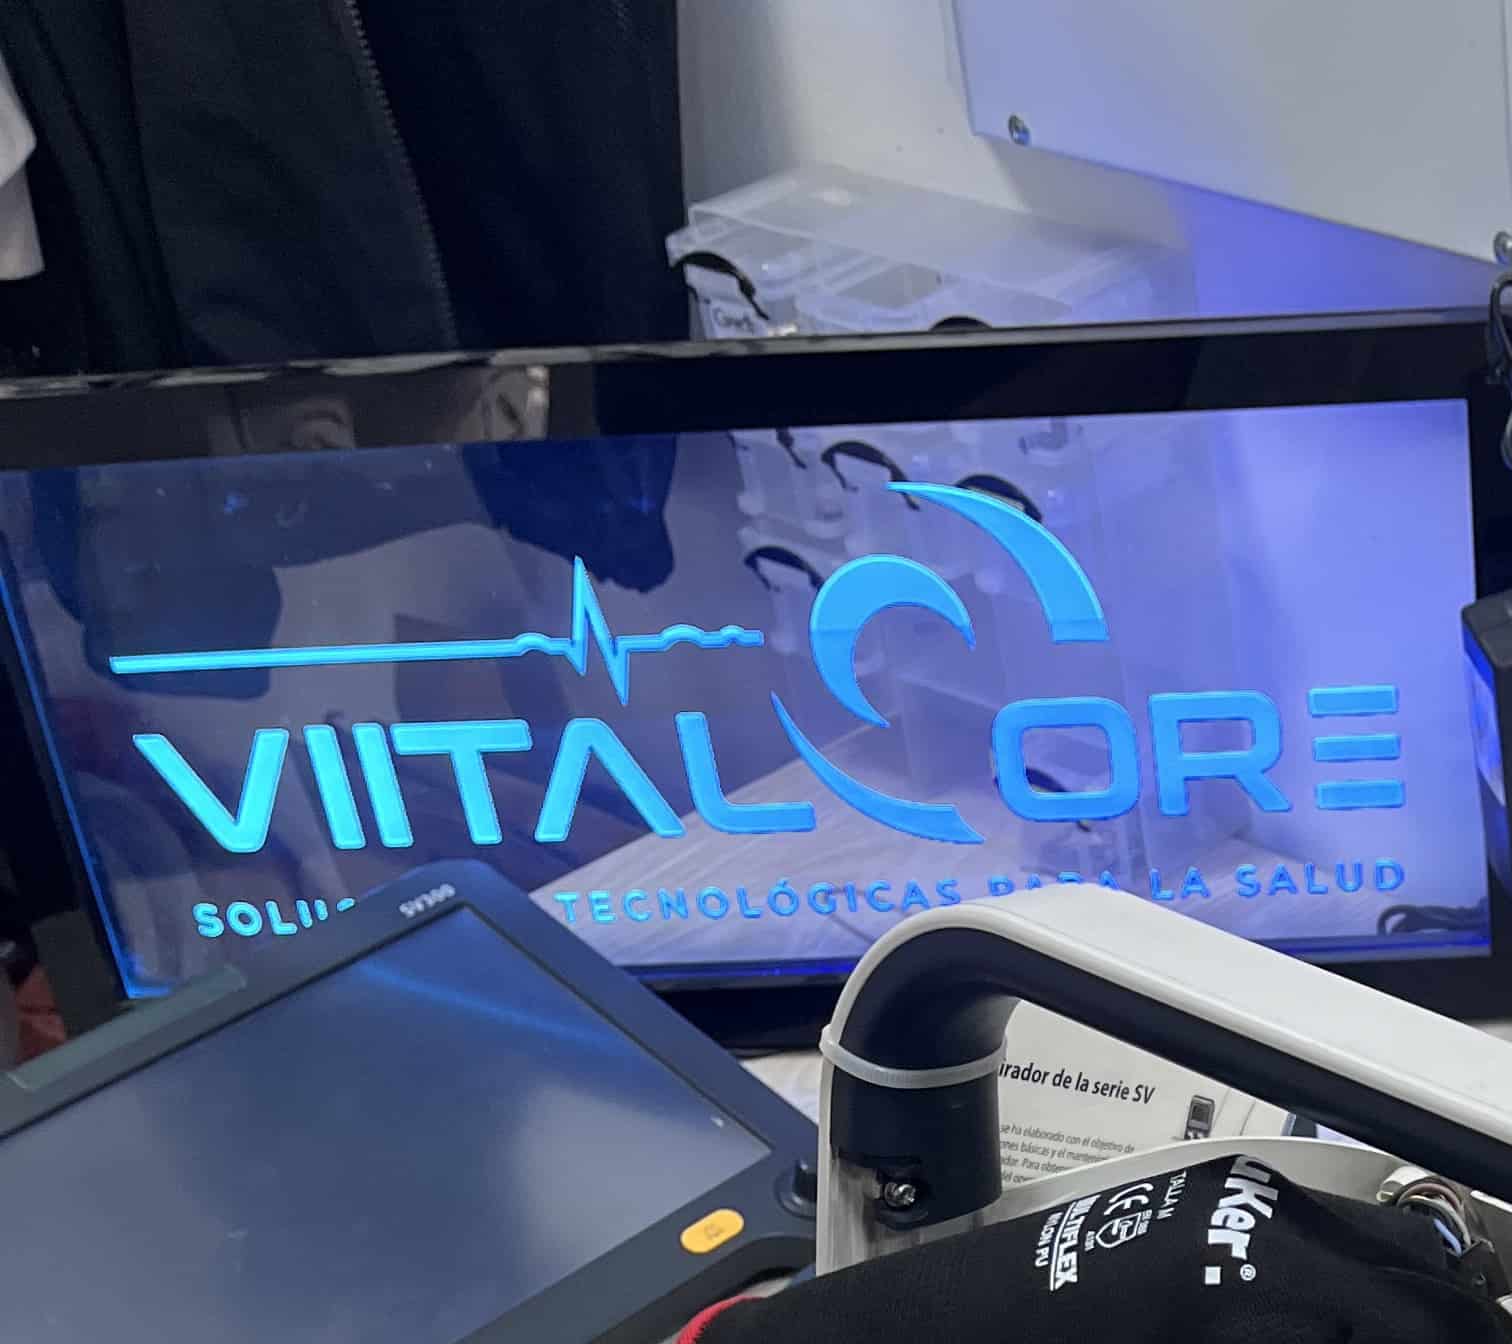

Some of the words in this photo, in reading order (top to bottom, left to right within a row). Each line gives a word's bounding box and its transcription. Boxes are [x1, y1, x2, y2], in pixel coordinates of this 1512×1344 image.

[552, 877, 962, 924] TECNOLÓGICAS
[1150, 866, 1211, 901] LA
[1235, 857, 1406, 899] SALUD
[1052, 1068, 1073, 1089] de
[1075, 1071, 1090, 1093] la
[1091, 1080, 1131, 1101] serie
[1131, 1084, 1156, 1105] SV
